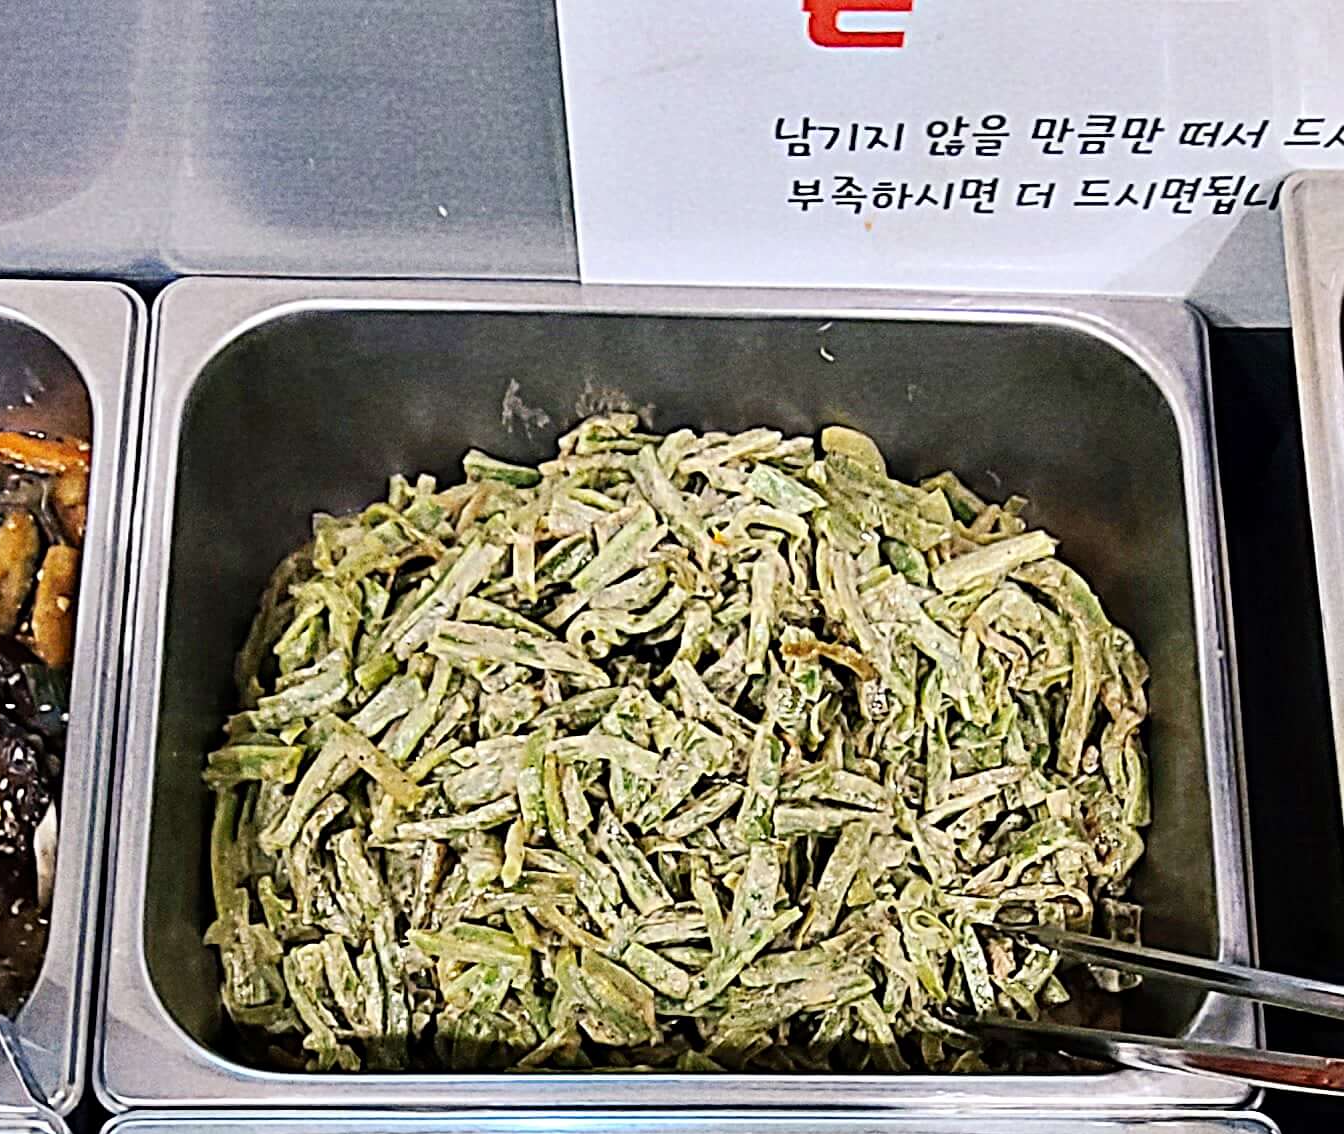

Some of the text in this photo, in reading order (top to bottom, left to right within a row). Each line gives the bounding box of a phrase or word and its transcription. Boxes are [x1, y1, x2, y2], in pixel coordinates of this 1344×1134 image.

[774, 116, 905, 157] 남기지
[925, 114, 1011, 157] 않을
[1031, 114, 1165, 156] 만큼만
[1178, 118, 1270, 149] 떠서
[787, 175, 1000, 215] 부족하시면
[1015, 181, 1057, 210] 더
